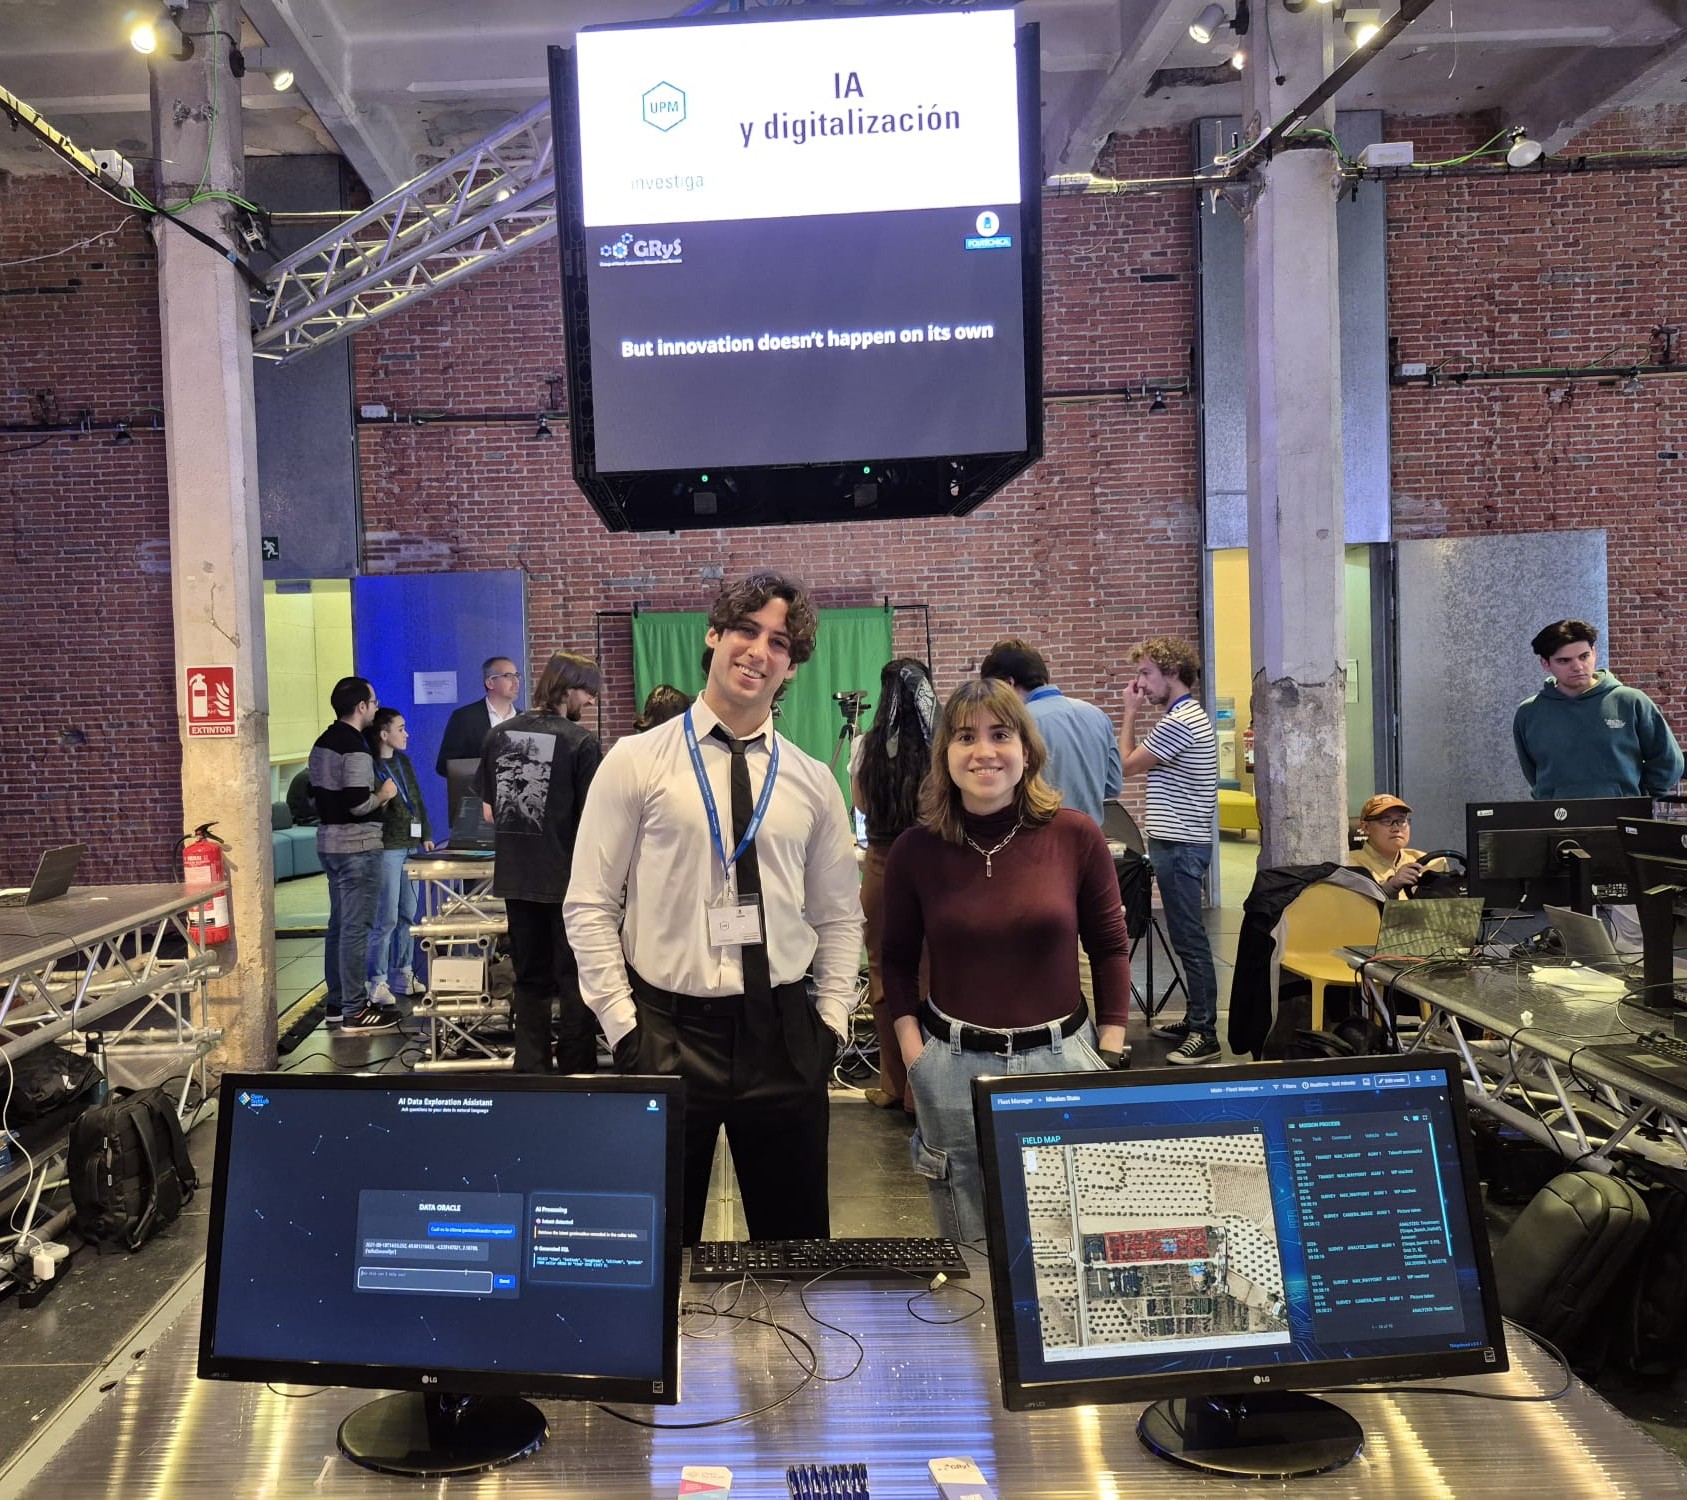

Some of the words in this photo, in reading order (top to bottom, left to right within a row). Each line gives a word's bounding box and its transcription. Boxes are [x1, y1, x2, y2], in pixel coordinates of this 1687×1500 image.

[834, 72, 864, 99] IA
[650, 101, 679, 113] UPM
[740, 121, 753, 148] y
[764, 103, 960, 145] digitalización
[633, 238, 682, 259] GRyS
[622, 341, 654, 358] But
[657, 335, 754, 356] innovation
[757, 332, 824, 351] doesn't
[828, 329, 895, 350] happen
[900, 328, 923, 343] on
[928, 324, 951, 341] its
[955, 325, 994, 340] own
[192, 726, 232, 734] EXTINTOR
[1554, 808, 1567, 821] hp
[424, 1098, 462, 1107] Exploration
[463, 1097, 493, 1106] Assistant
[1023, 1137, 1043, 1145] FIELD
[1044, 1135, 1061, 1144] MAP
[419, 1203, 436, 1211] DATA
[437, 1204, 461, 1212] ORACLE
